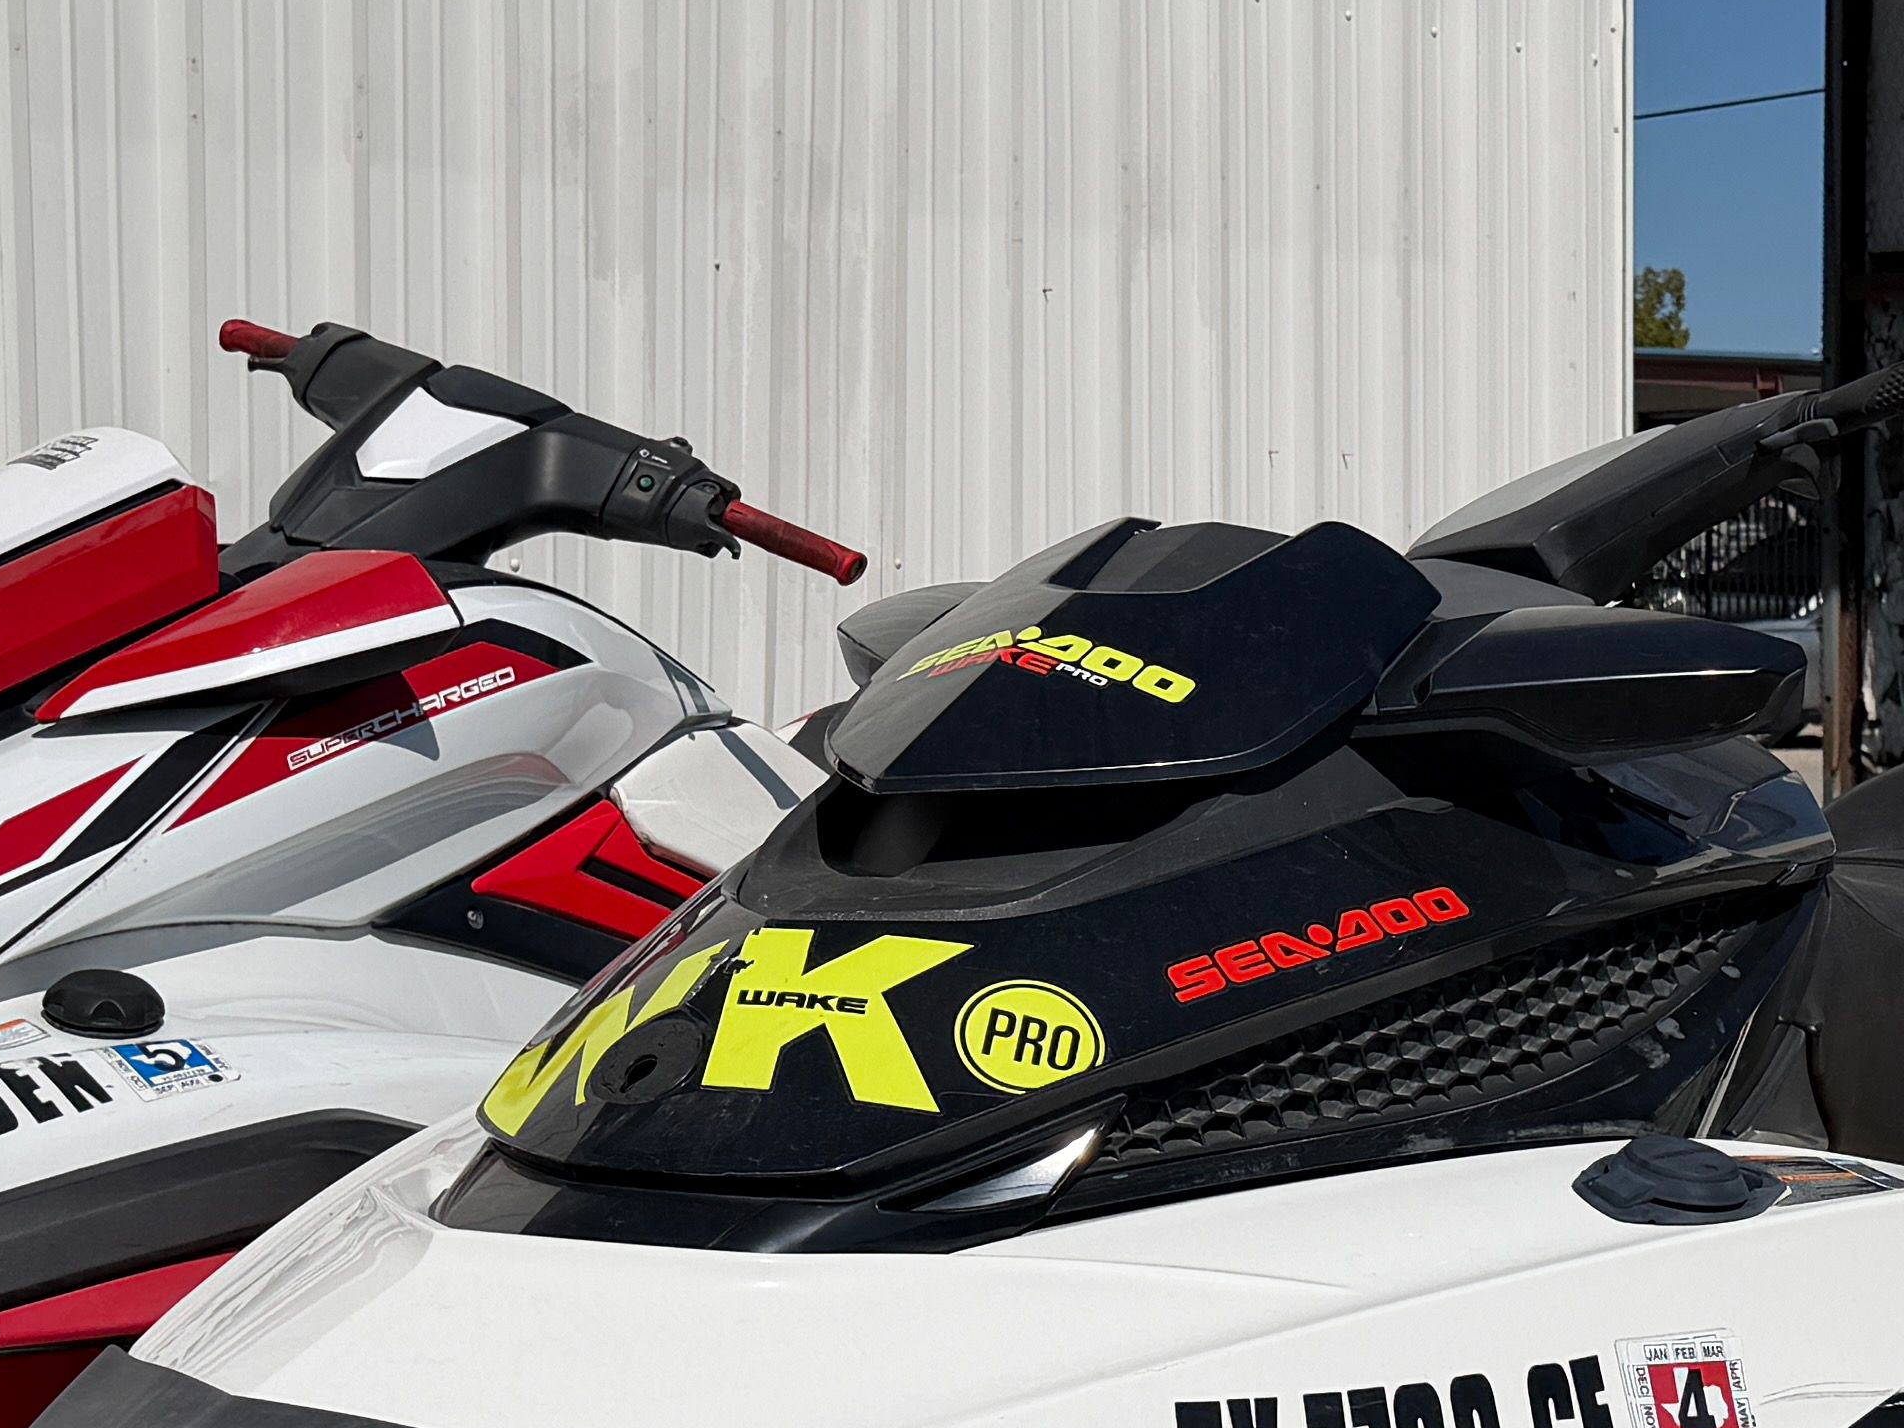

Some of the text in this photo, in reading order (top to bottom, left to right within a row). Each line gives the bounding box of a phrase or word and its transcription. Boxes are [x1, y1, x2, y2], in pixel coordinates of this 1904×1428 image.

[1055, 663, 1109, 687] PRO
[287, 666, 516, 771] SUPERCHARGED
[737, 989, 869, 1015] WAKE
[982, 1008, 1082, 1072] PRO
[140, 1039, 187, 1072] 5
[1646, 1347, 1668, 1362] JAN
[1674, 1345, 1696, 1360] FEB
[1702, 1344, 1726, 1359] MAR
[1635, 1367, 1650, 1396] DEC
[1730, 1361, 1742, 1388] APR
[1737, 1401, 1752, 1428] MAY
